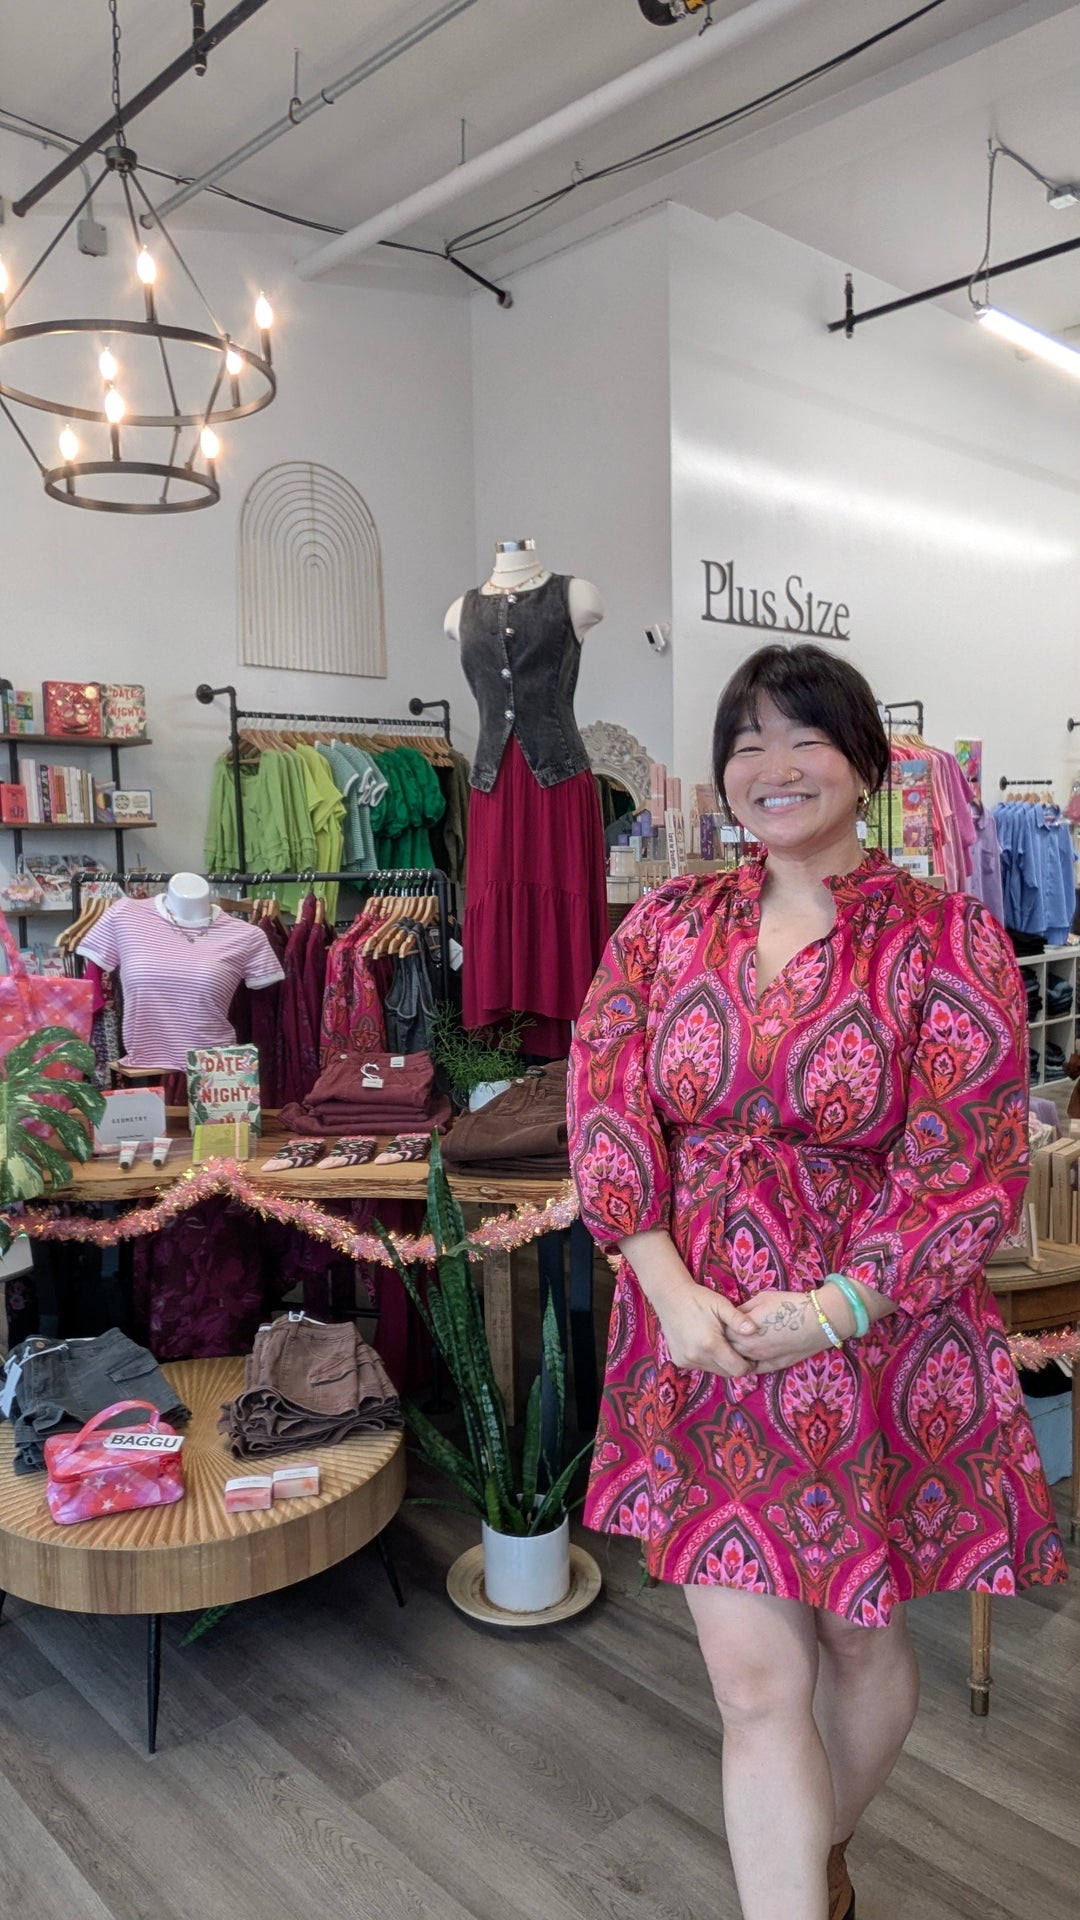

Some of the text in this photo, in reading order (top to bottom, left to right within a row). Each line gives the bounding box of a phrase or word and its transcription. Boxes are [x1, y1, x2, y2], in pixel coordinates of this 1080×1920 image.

[701, 560, 850, 639] Plus Size
[112, 688, 136, 699] DATE
[110, 706, 140, 717] NIGHT
[205, 1057, 244, 1073] DATE
[202, 1087, 251, 1104] NIGHT
[112, 1116, 148, 1124] GEOMETRY
[110, 1434, 178, 1449] BAGGU
